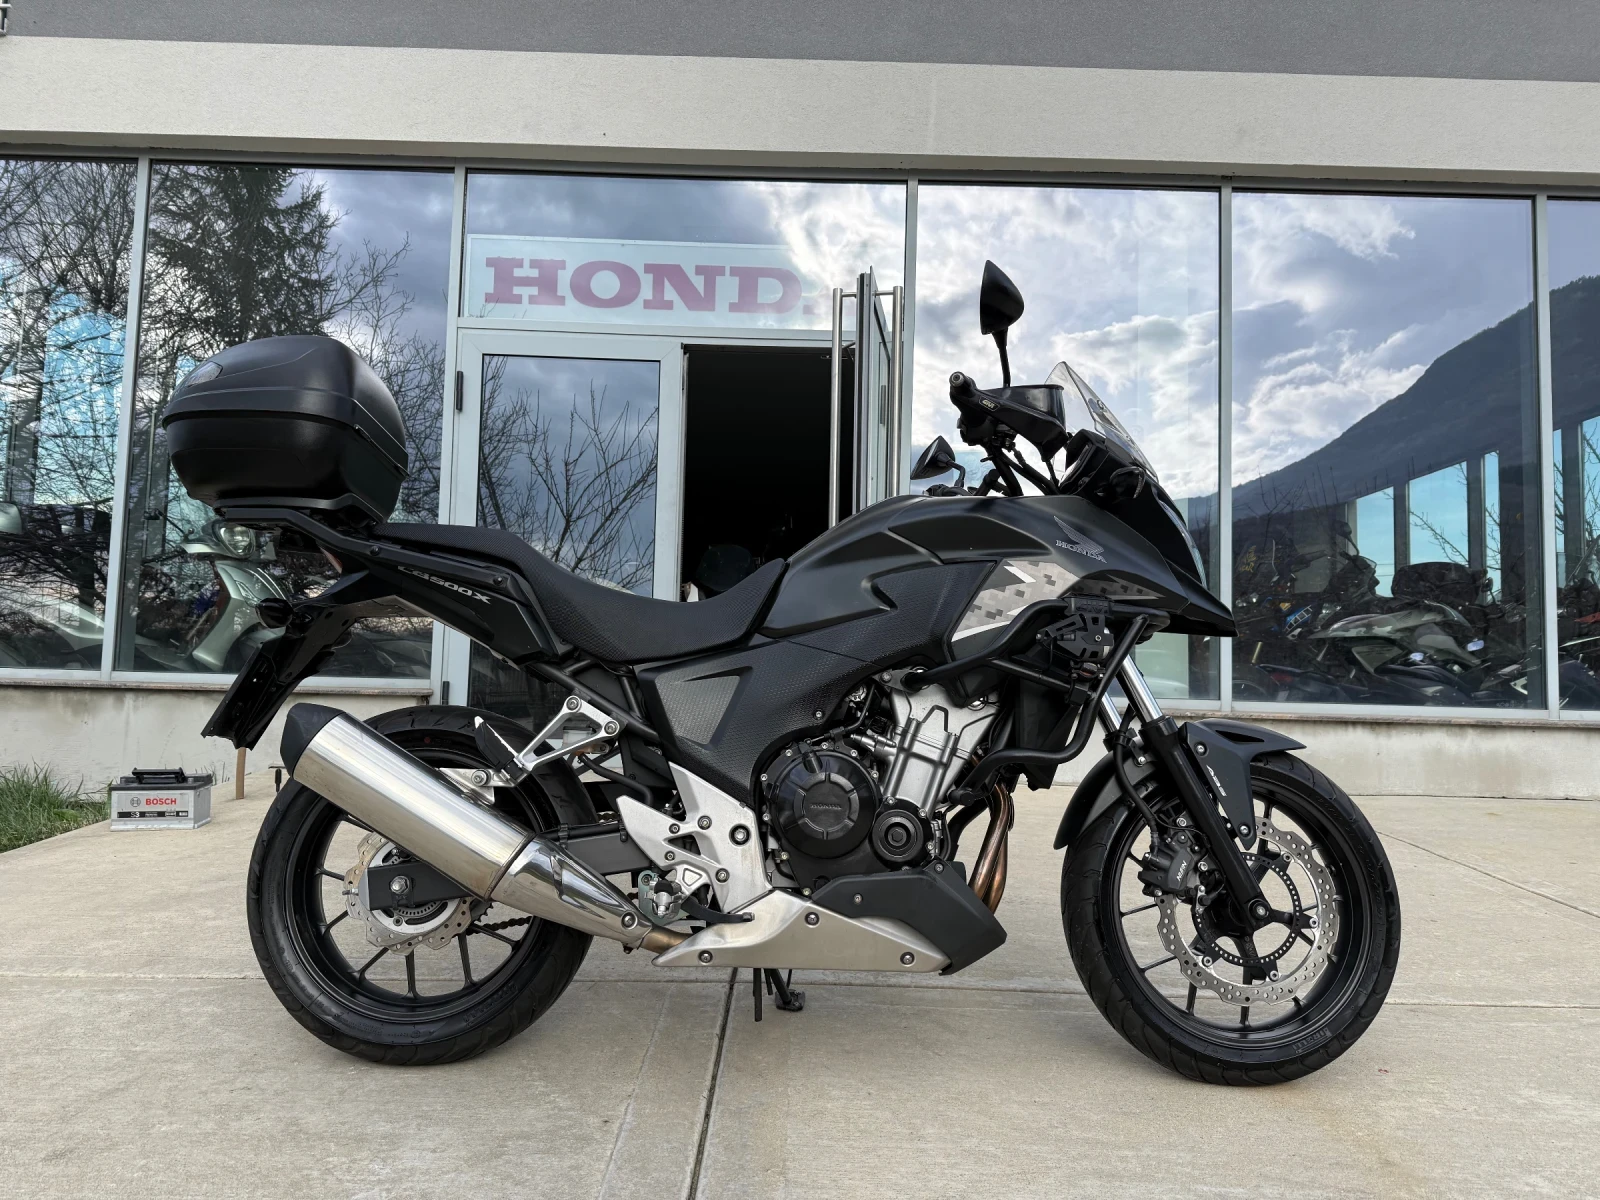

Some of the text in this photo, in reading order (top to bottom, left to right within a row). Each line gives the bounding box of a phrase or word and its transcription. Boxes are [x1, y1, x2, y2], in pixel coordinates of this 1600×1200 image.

[484, 256, 856, 315] HOND
[1055, 539, 1108, 564] HONDA
[145, 797, 177, 806] BOSCH
